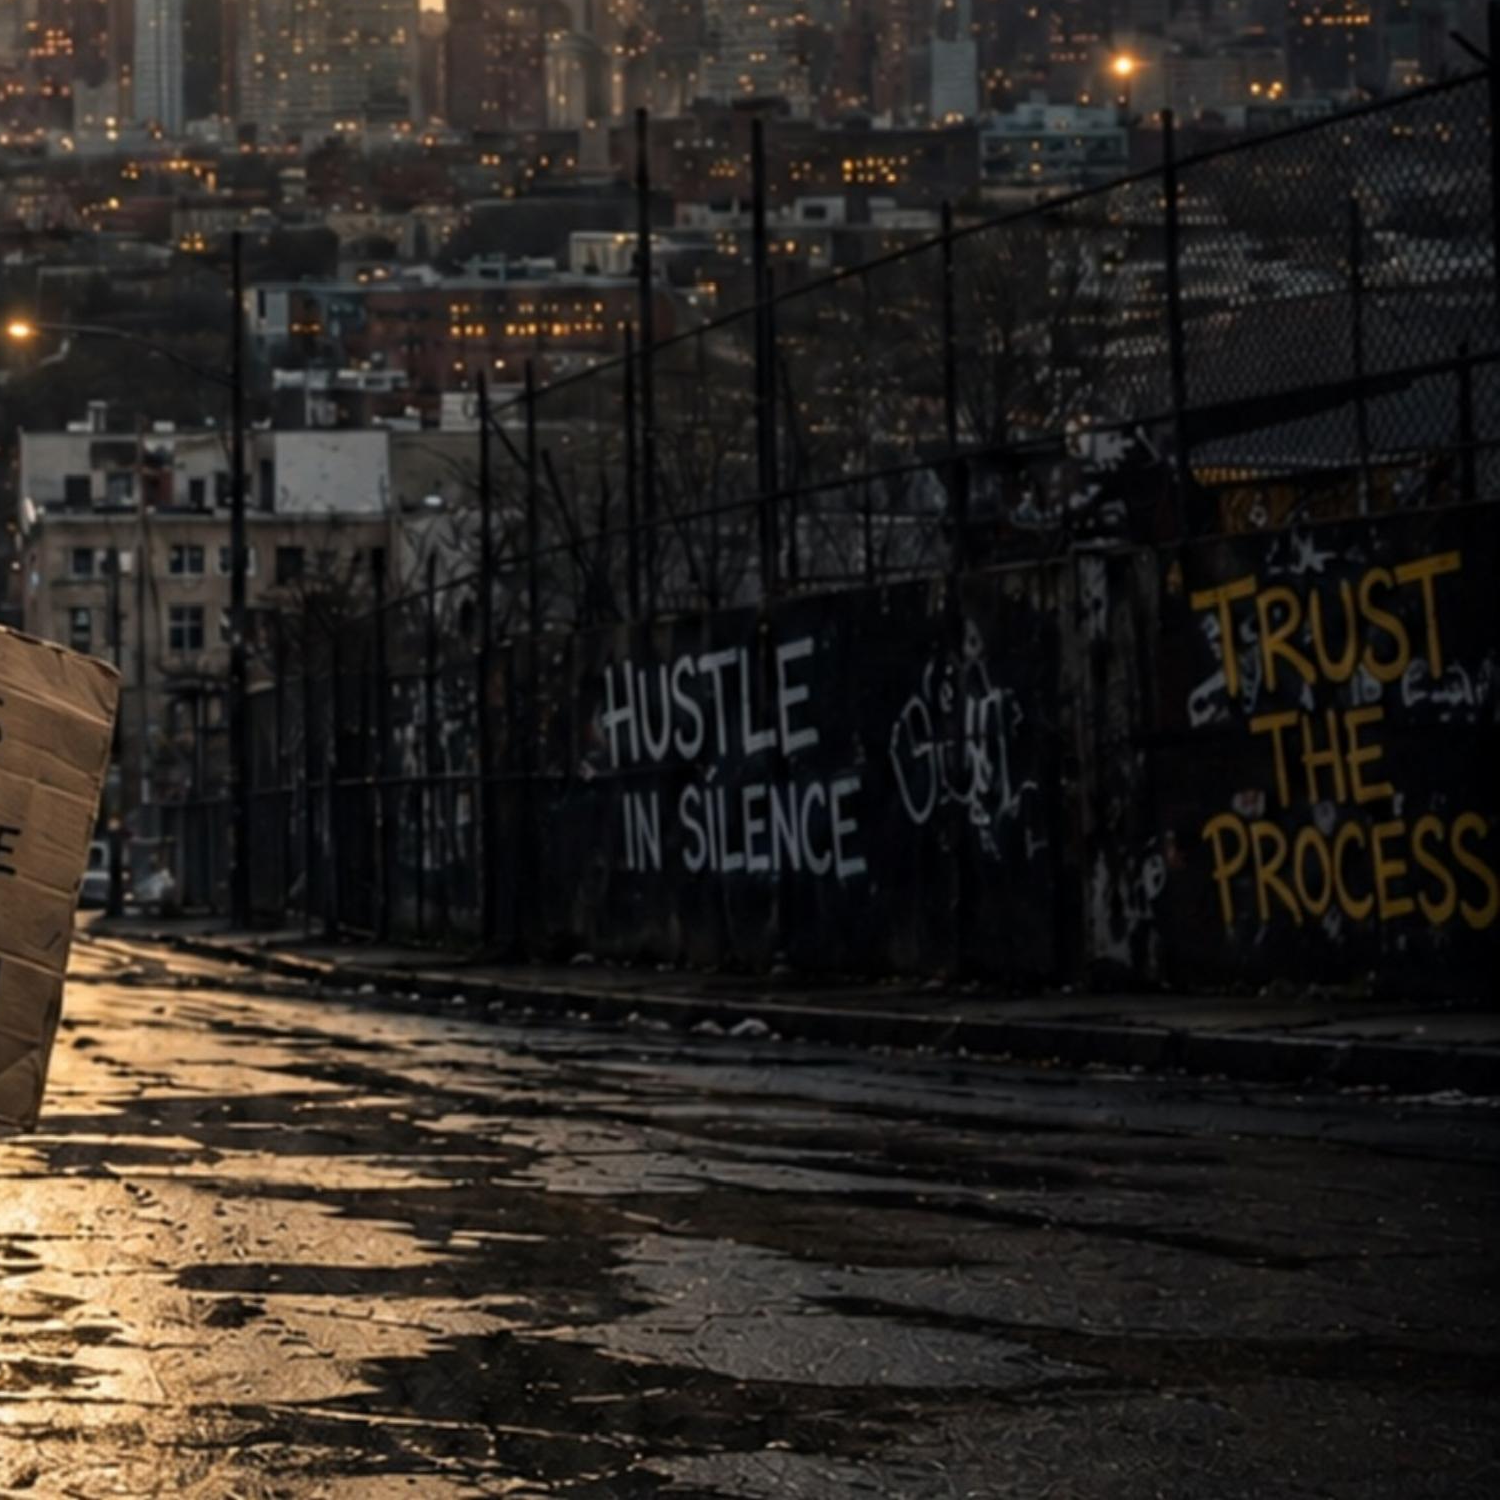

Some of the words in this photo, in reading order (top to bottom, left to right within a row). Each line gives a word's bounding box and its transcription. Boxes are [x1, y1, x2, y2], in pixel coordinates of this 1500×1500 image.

[1190, 551, 1461, 697] TRUST
[602, 637, 819, 768] HUSTLE
[1249, 705, 1396, 808] THE
[623, 791, 662, 872] IN
[1202, 811, 1500, 930] PROCESS
